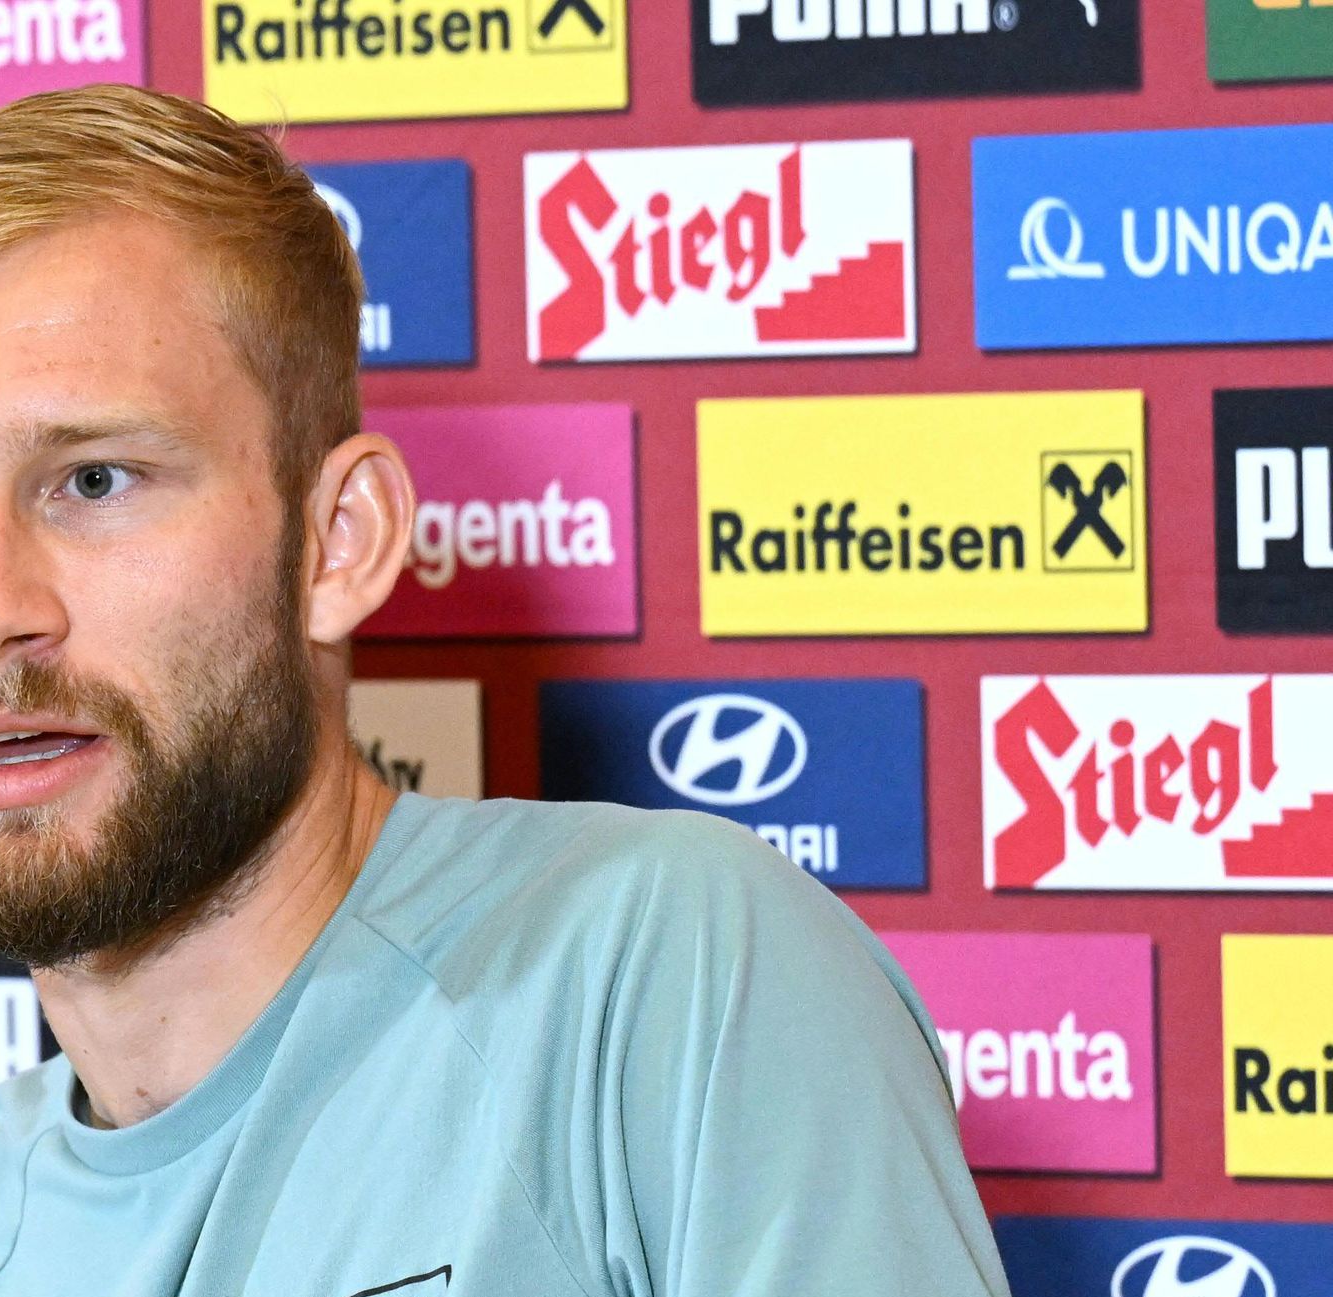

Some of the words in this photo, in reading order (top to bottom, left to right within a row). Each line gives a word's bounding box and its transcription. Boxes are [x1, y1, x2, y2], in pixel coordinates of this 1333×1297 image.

[215, 0, 511, 64] Raiffeisen
[538, 146, 807, 359] Stiegl
[402, 477, 615, 590] genta
[709, 500, 1025, 576] Raiffeisen
[994, 677, 1278, 888] Stiegl
